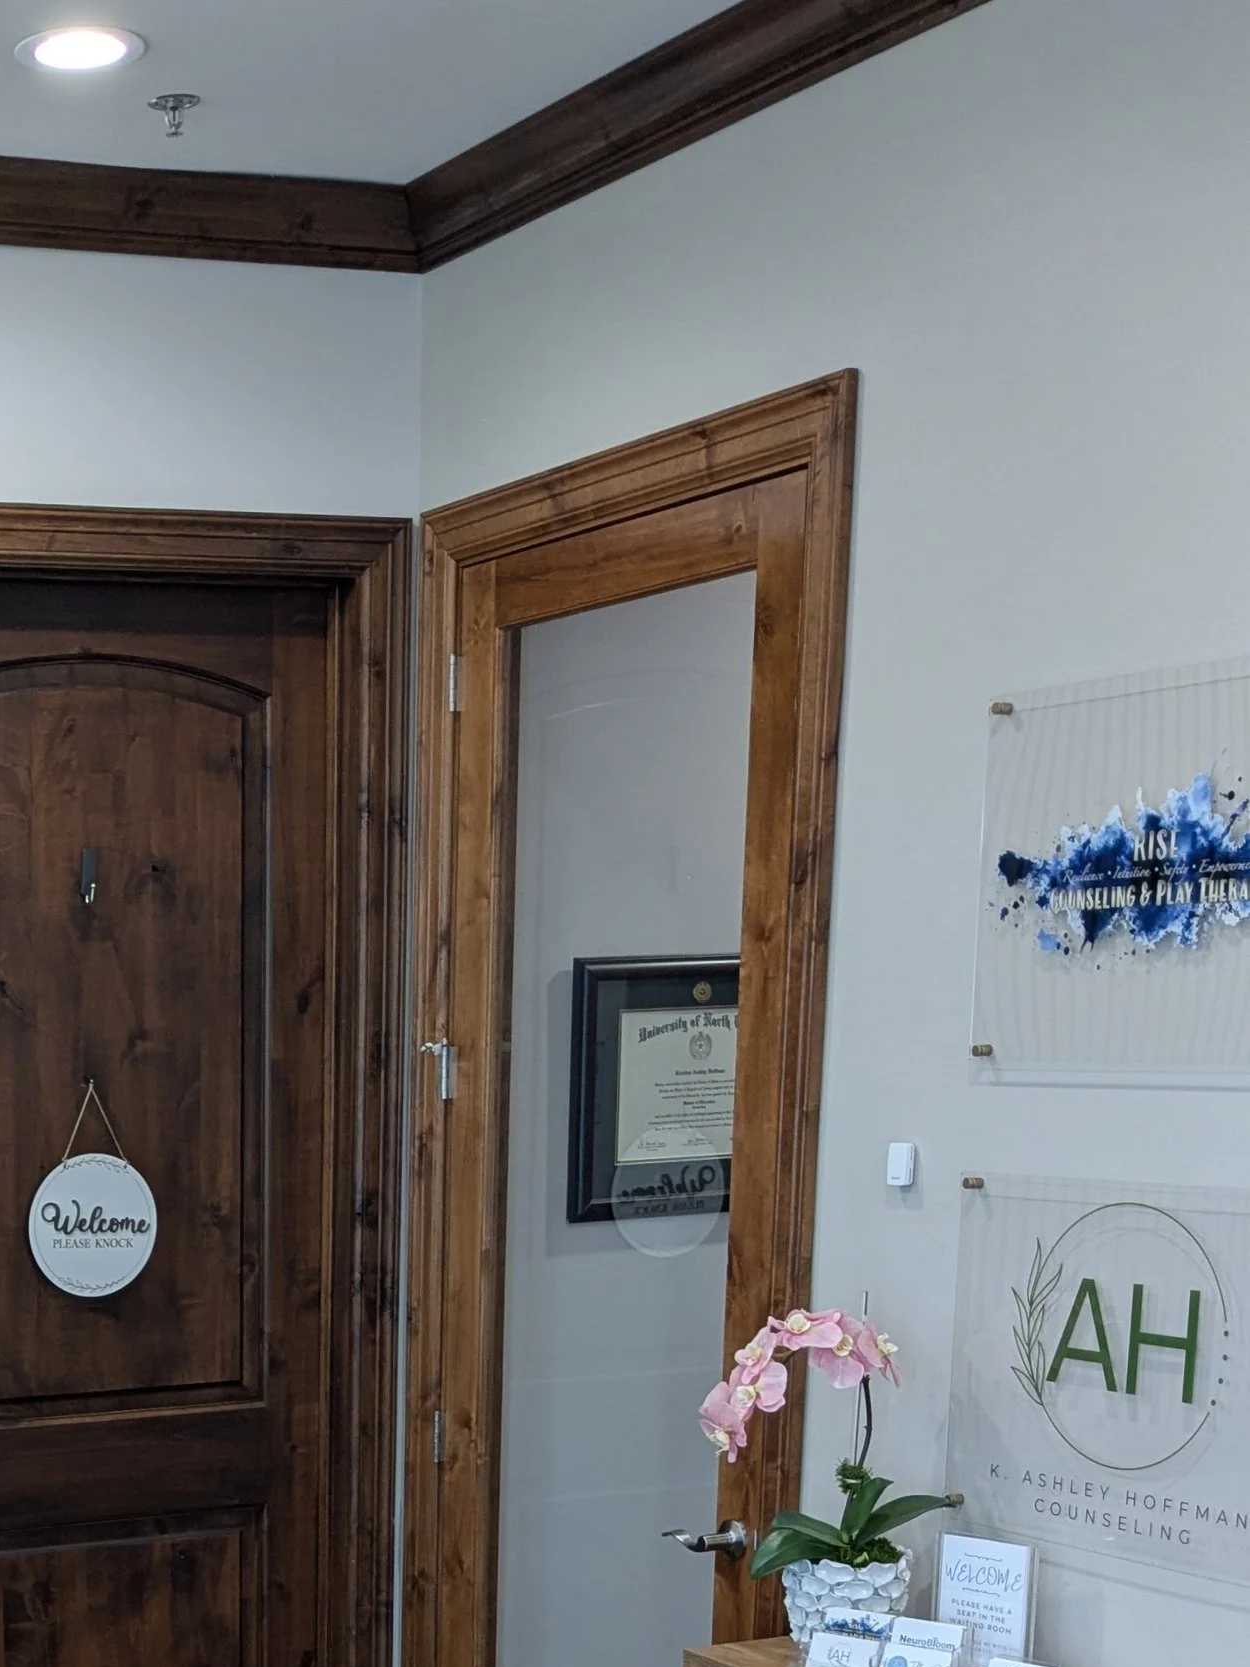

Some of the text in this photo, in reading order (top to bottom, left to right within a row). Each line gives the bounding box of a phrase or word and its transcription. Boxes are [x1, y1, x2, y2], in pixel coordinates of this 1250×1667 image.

[1133, 829, 1180, 861] RISE
[1159, 858, 1190, 885] Safety
[1050, 884, 1136, 914] COUNSELING
[1139, 881, 1153, 907] &
[1156, 878, 1193, 906] PLAY
[637, 1016, 689, 1044] University
[690, 1014, 702, 1028] of
[702, 1011, 732, 1030] North
[41, 1199, 151, 1236] Welcome
[52, 1237, 134, 1249] PLEASE KNOCK
[1046, 1277, 1201, 1404] AH
[989, 1463, 1249, 1530] K. ASHLEY HOFFMAN
[1033, 1498, 1191, 1545] COUNSELING
[945, 1559, 1024, 1593] WELCOME
[951, 1598, 1012, 1616] PLEASE HAVE A
[956, 1608, 1006, 1624] SEAT IN THE
[949, 1616, 1012, 1635] WAITING ROOM
[831, 1648, 852, 1664] AH
[899, 1633, 956, 1651] NeuroBloom
